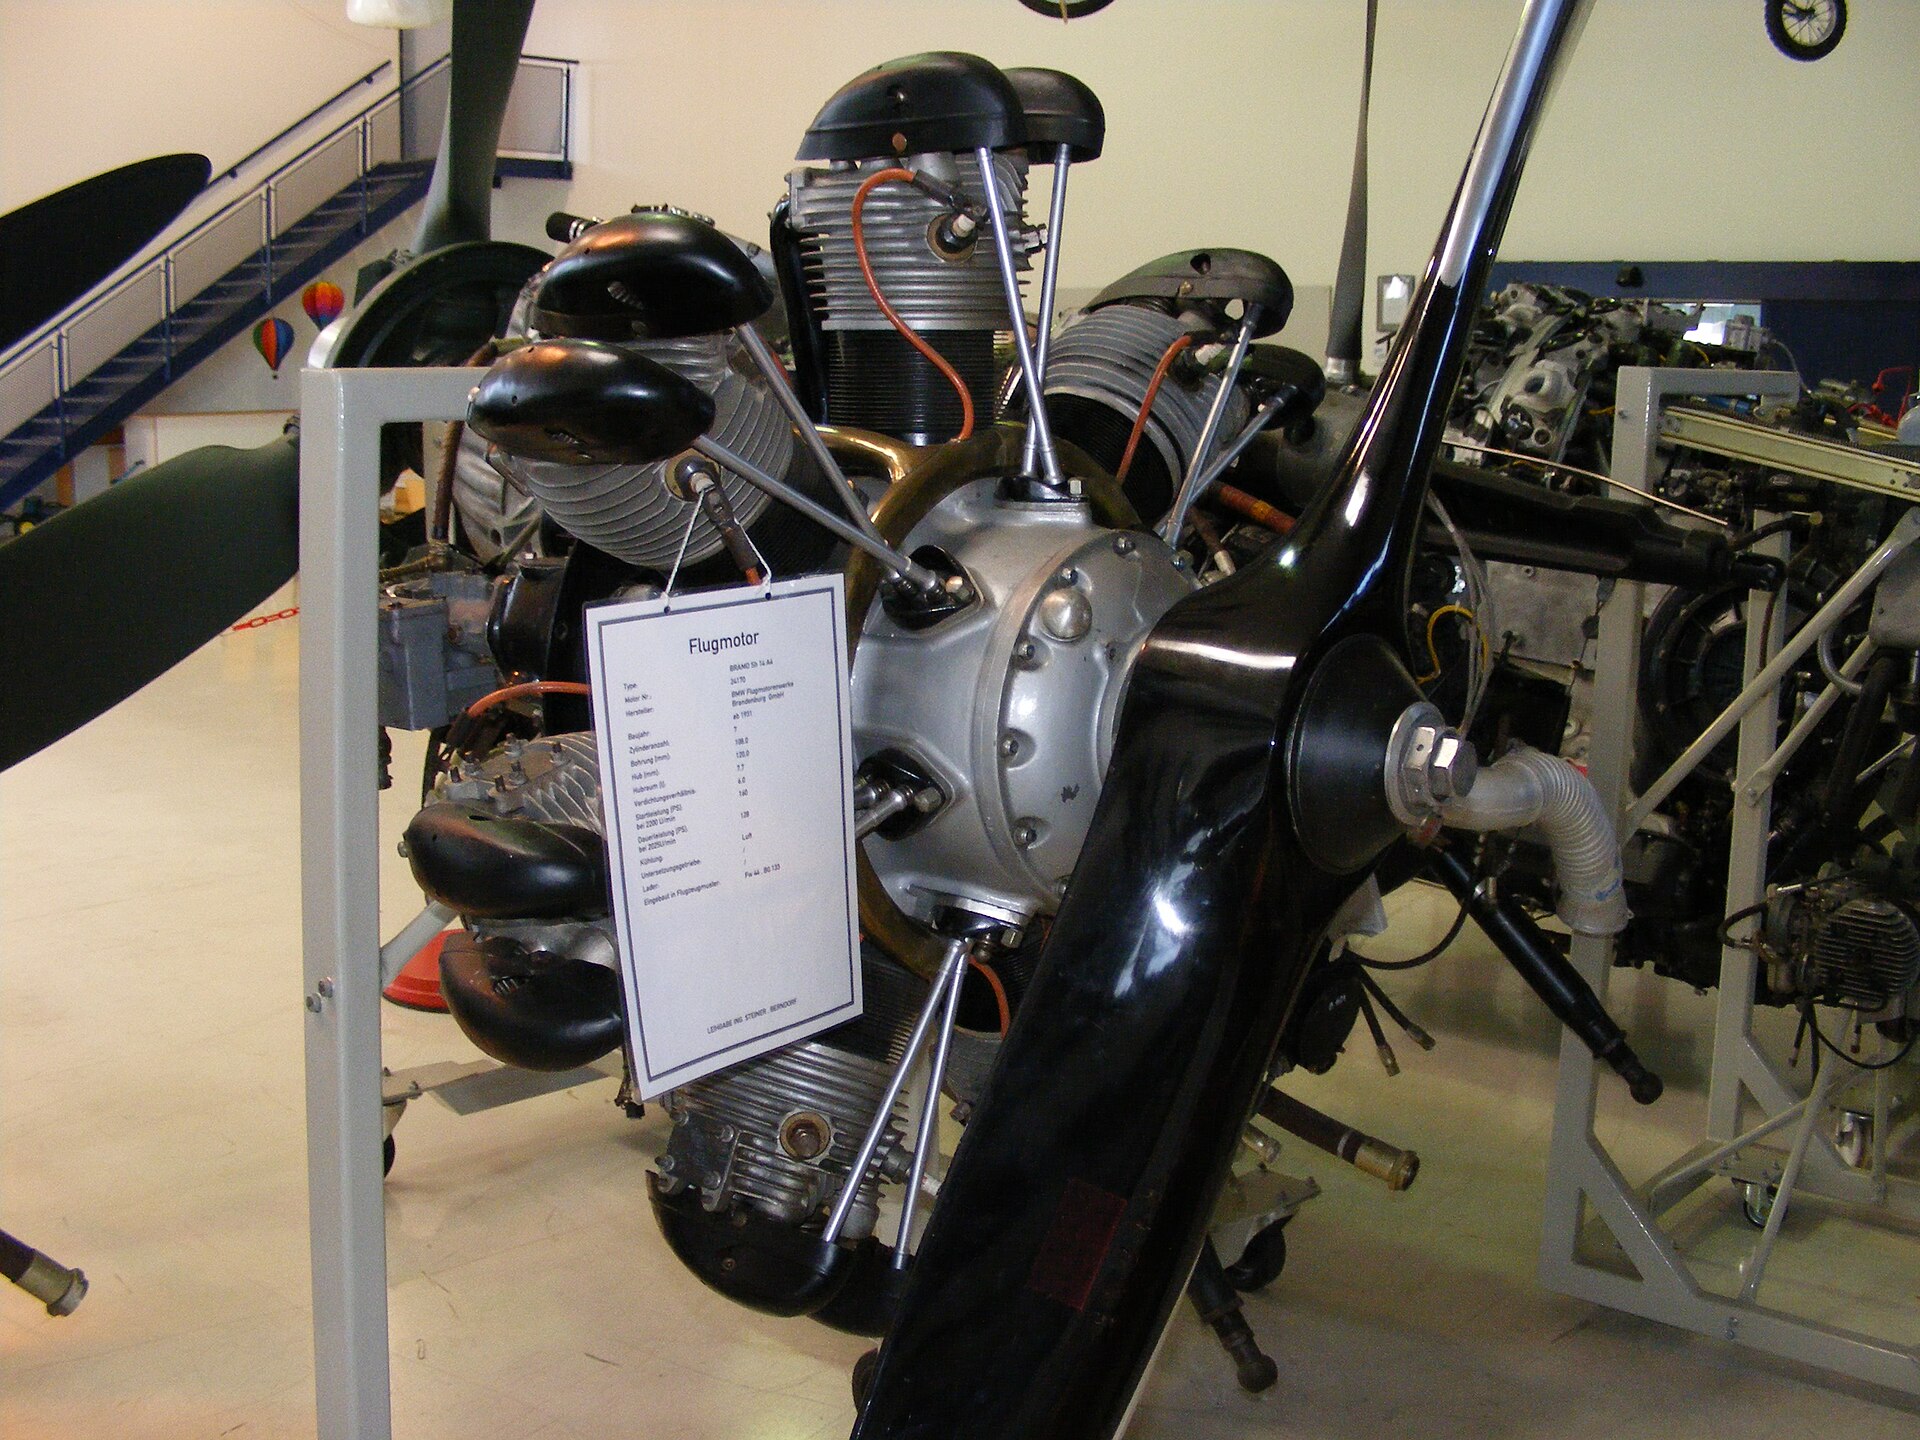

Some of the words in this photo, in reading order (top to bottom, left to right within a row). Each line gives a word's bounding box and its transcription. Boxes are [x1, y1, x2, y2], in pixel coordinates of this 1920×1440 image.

[689, 632, 759, 654] Flugmotor
[732, 696, 766, 707] Brandenburg
[768, 692, 784, 700] GmbH
[631, 758, 654, 767] Bohrung
